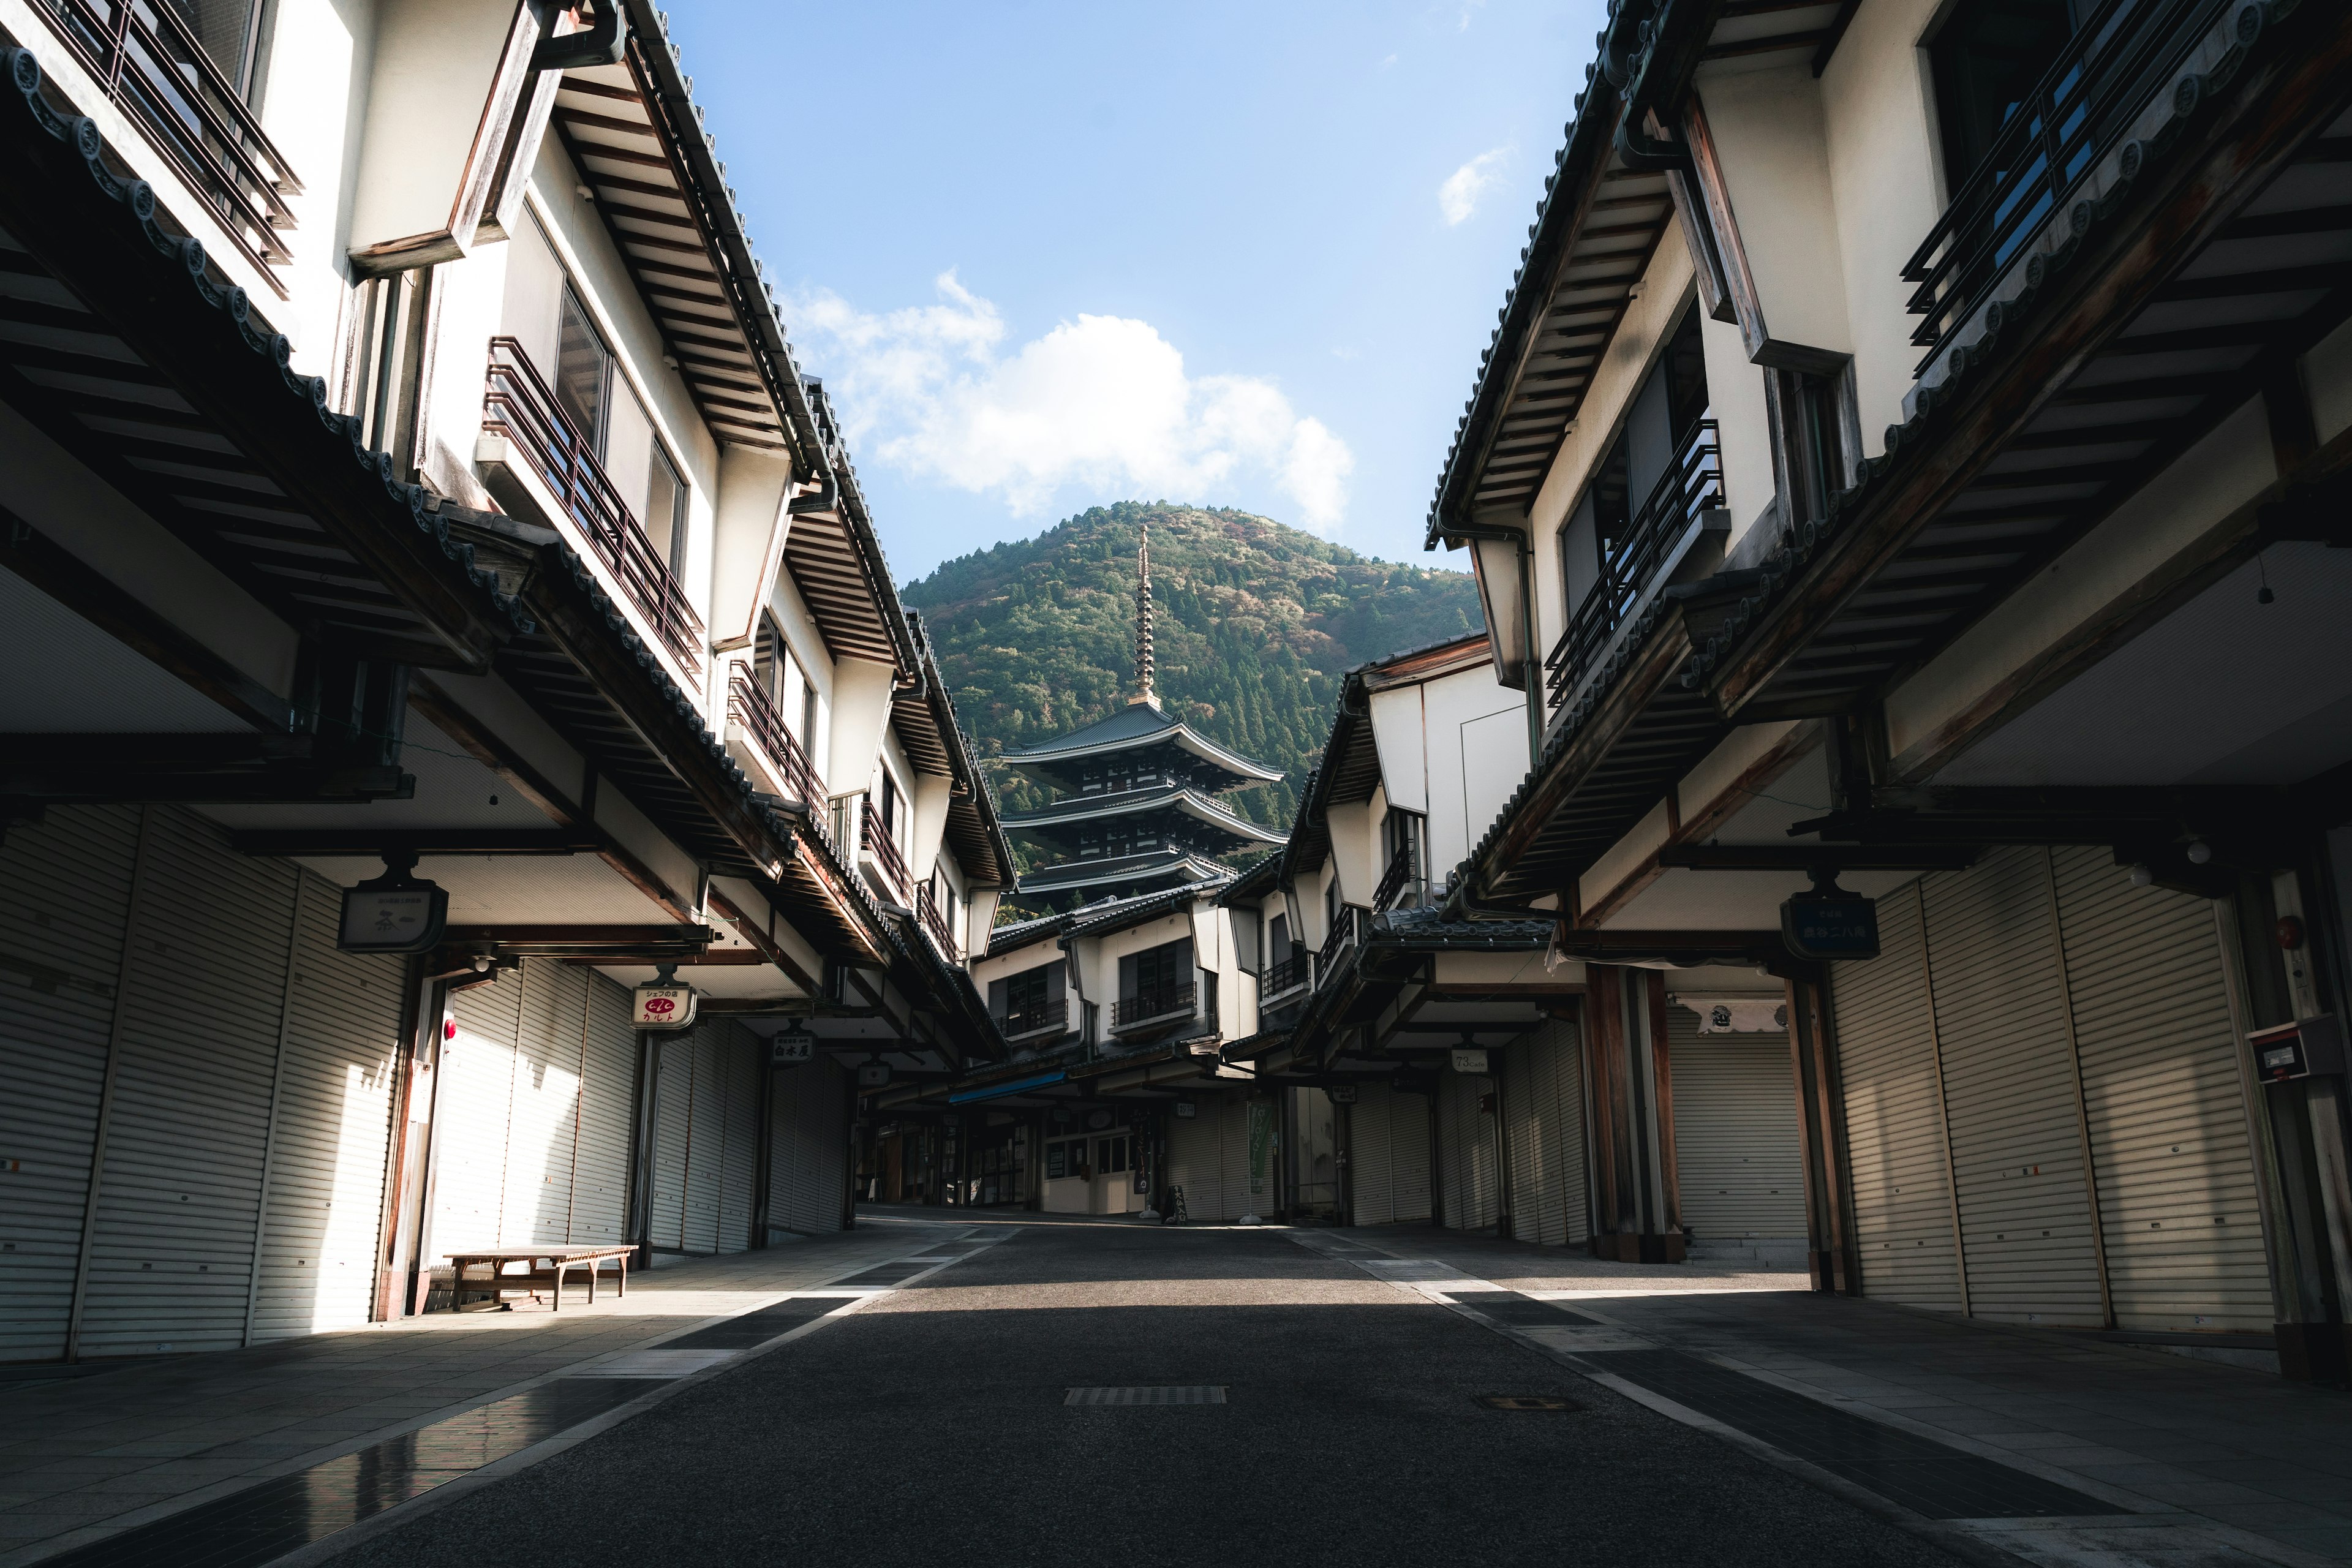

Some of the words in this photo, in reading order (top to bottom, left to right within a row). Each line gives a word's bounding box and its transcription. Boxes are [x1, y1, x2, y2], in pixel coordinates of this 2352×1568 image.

[643, 1012, 673, 1022] カルト
[1174, 1191, 1186, 1221] 大仏入口
